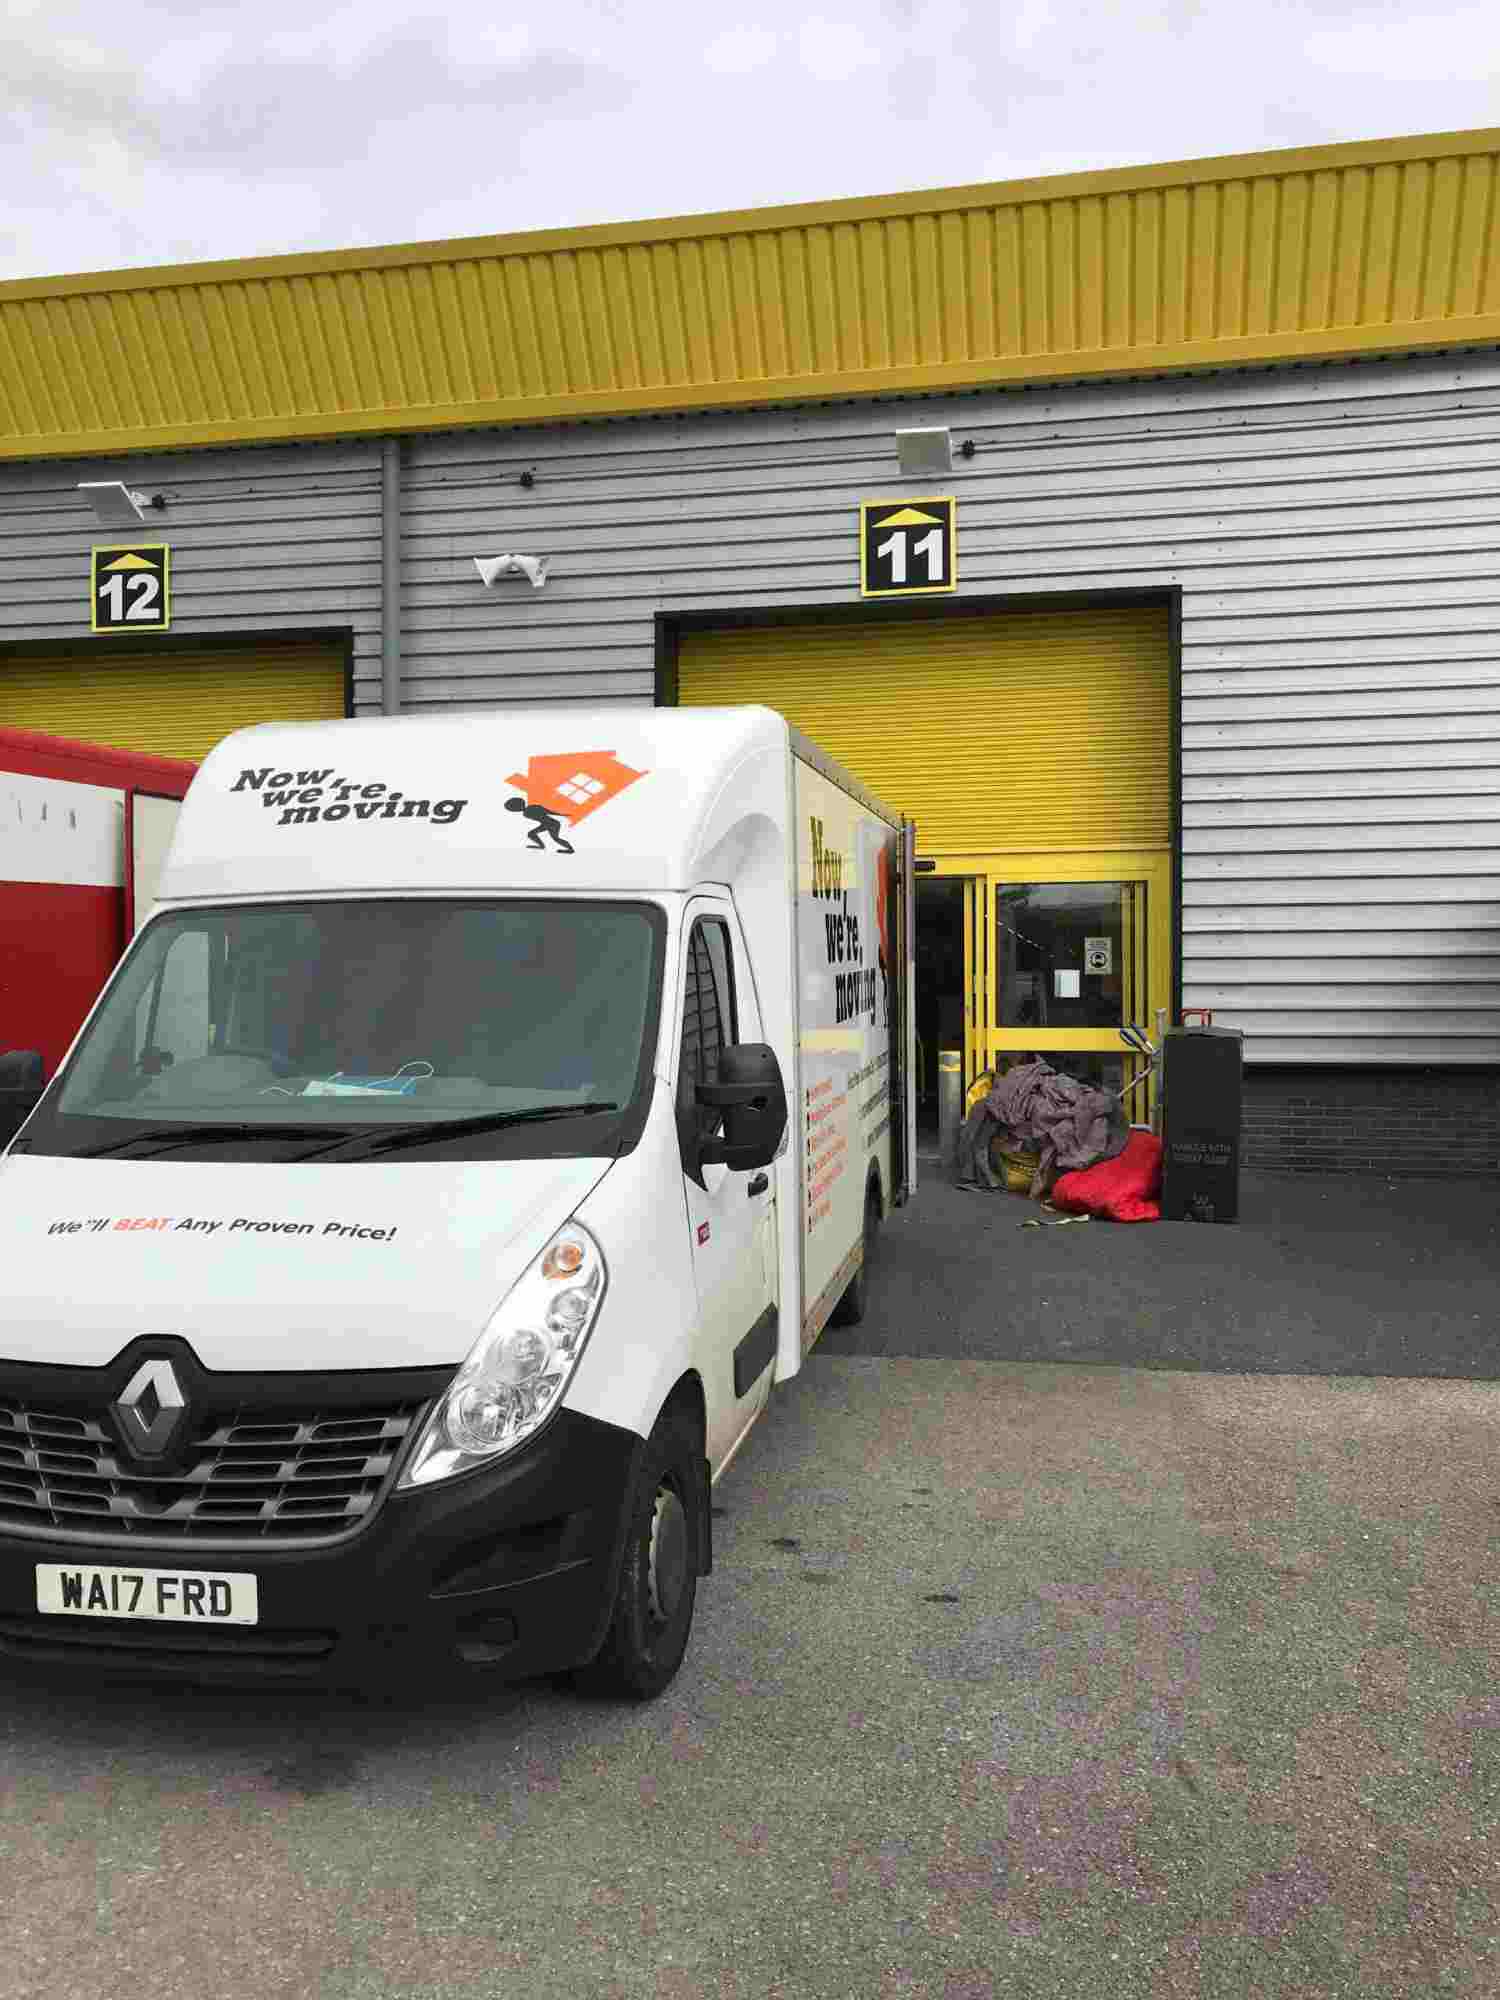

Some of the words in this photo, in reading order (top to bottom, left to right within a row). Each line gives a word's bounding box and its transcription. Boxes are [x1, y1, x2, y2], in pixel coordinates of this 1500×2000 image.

[877, 529, 944, 583] 11
[99, 573, 160, 621] 12
[229, 767, 336, 792] Now
[262, 777, 387, 807] we're
[277, 791, 469, 825] moving
[835, 952, 877, 1027] moving
[112, 1218, 175, 1232] BEAT
[174, 1217, 224, 1234] Any
[228, 1217, 316, 1236] Proven
[321, 1221, 399, 1242] Price!
[59, 1570, 145, 1613] WA17
[155, 1575, 234, 1618] FRD
